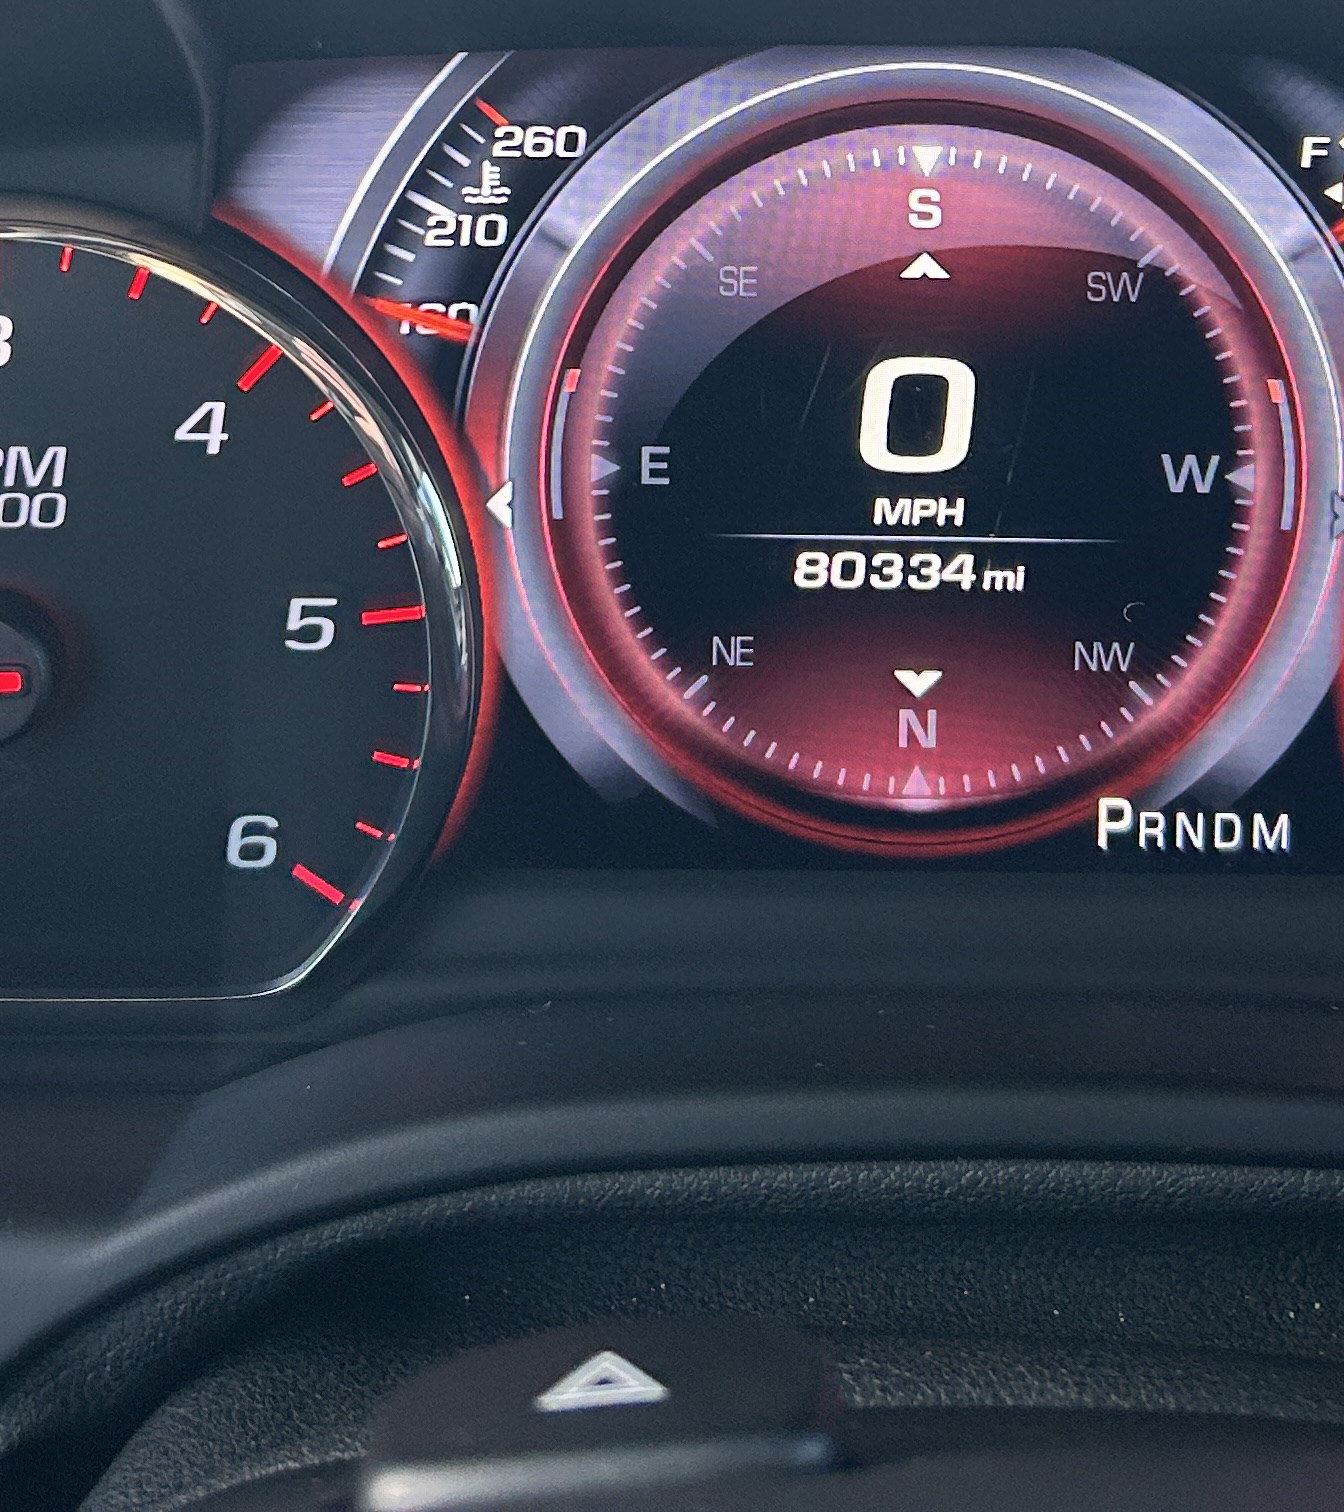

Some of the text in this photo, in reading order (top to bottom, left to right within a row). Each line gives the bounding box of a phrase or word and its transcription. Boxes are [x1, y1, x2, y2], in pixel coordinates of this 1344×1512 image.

[492, 124, 587, 158] 260
[1300, 136, 1332, 169] F
[908, 188, 942, 229] S
[424, 213, 508, 248] 210
[719, 264, 759, 297] SE
[1086, 272, 1144, 302] SW
[174, 401, 230, 455] 4
[859, 356, 976, 474] 0
[640, 445, 671, 485] E
[1160, 453, 1221, 494] W
[873, 496, 965, 527] MPH
[793, 550, 1026, 592] 80334 mi
[284, 597, 338, 651] 5
[712, 635, 754, 667] NE
[1074, 640, 1135, 672] NW
[898, 708, 937, 749] N
[226, 814, 280, 869] 6
